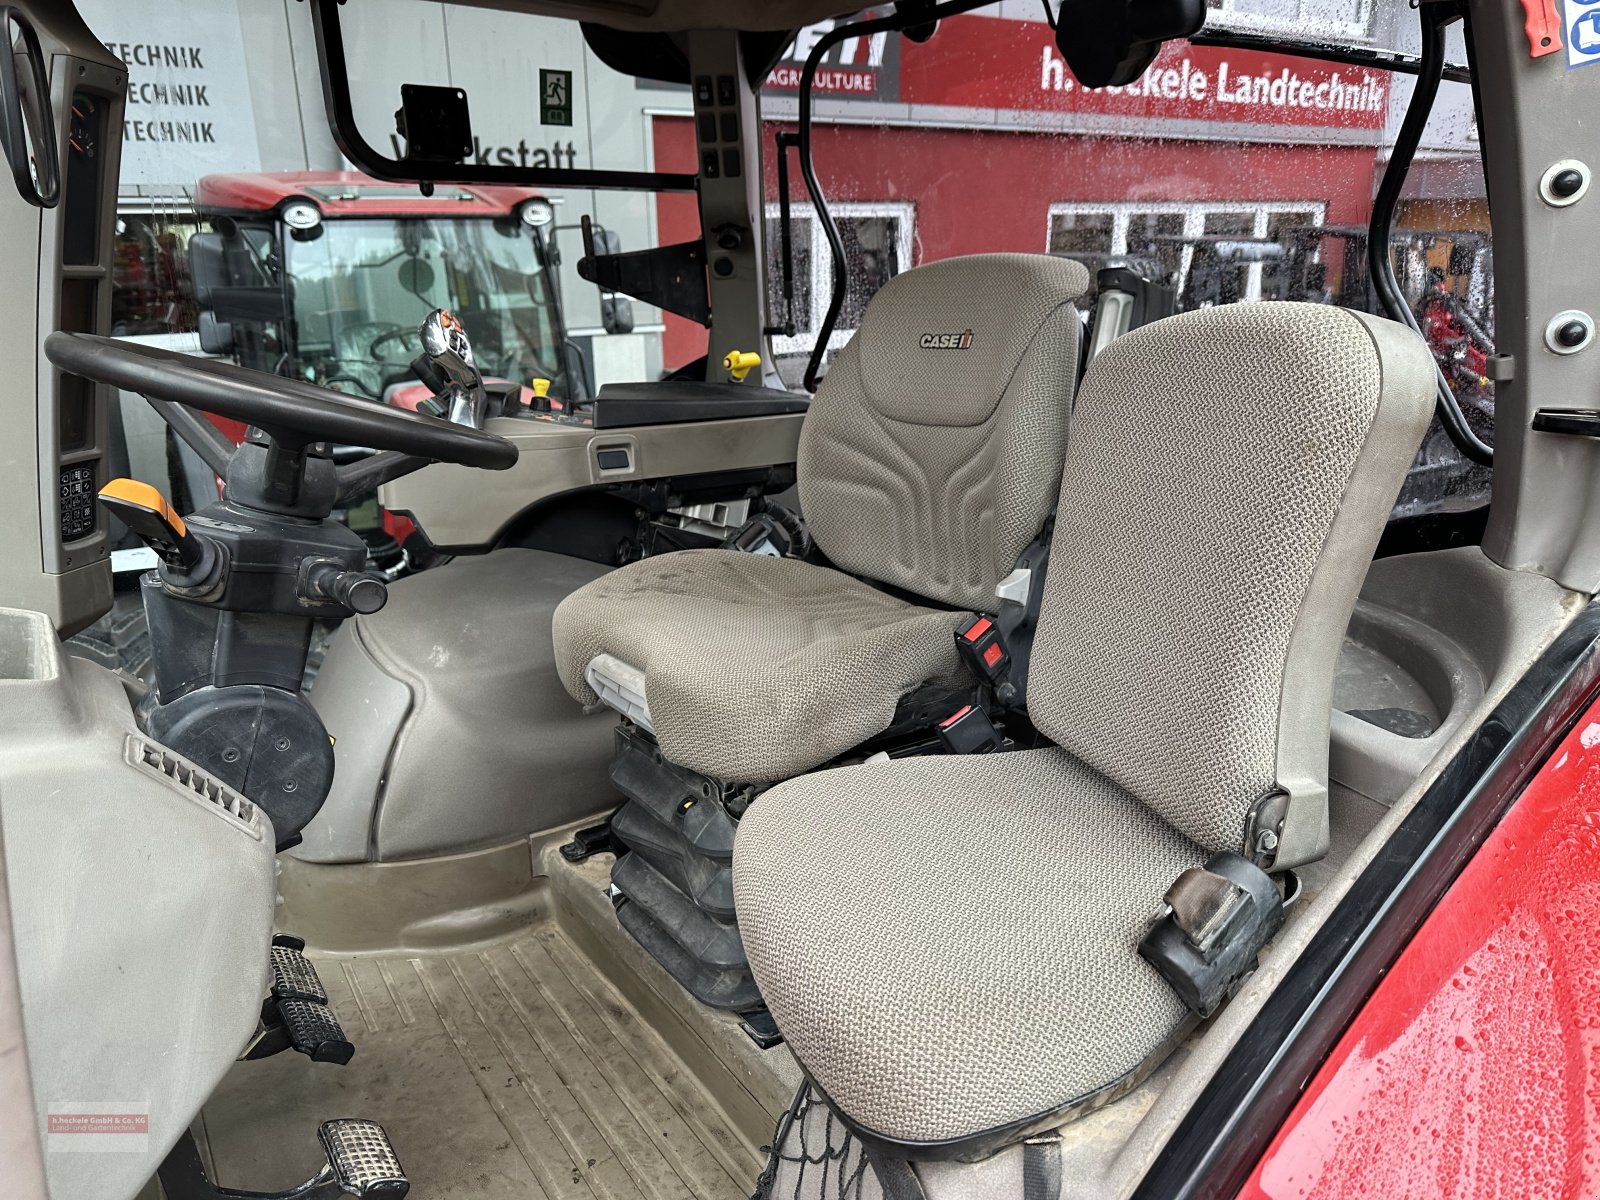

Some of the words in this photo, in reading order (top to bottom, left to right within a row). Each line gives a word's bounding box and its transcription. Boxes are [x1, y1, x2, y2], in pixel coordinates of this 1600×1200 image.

[766, 68, 872, 91] AGRIULTURE
[1082, 58, 1208, 101] kele
[1216, 61, 1384, 112] Landtechnik
[390, 134, 576, 169] kstatt
